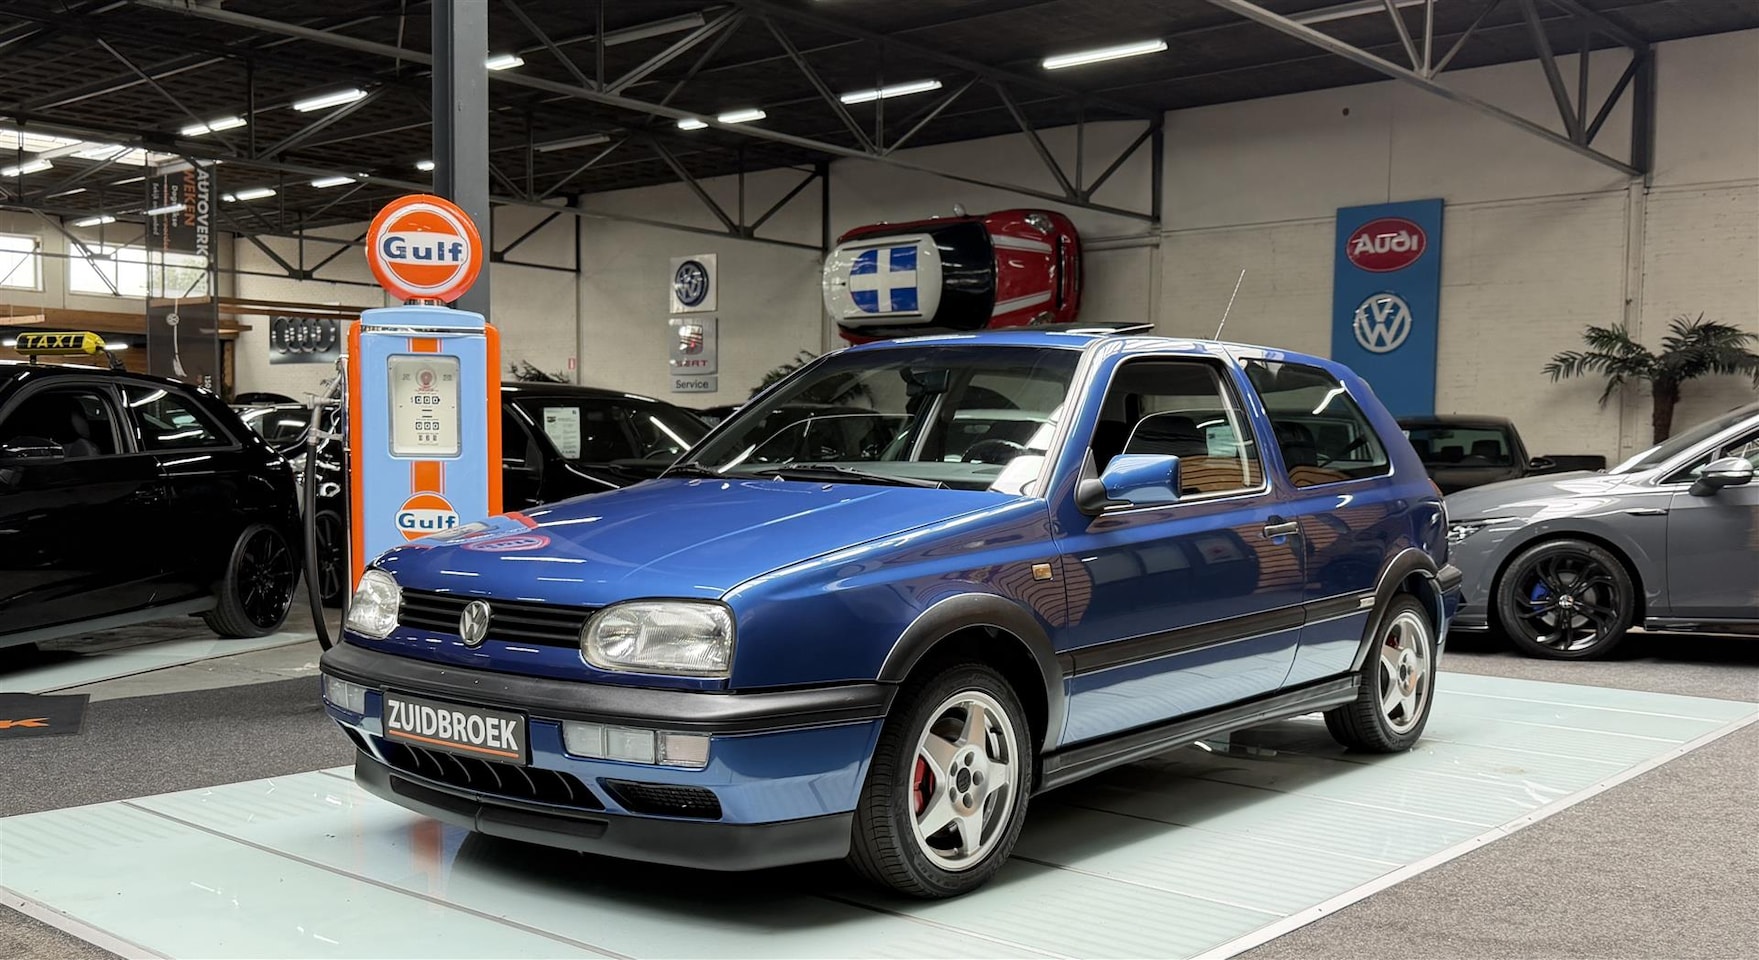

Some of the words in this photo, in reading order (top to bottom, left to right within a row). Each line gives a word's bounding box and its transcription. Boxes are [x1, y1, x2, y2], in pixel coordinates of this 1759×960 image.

[383, 236, 463, 262] Gulf
[26, 333, 77, 349] TAXI
[675, 379, 710, 389] Service
[398, 513, 456, 530] Gulf
[387, 699, 519, 751] ZUIDBROEK
